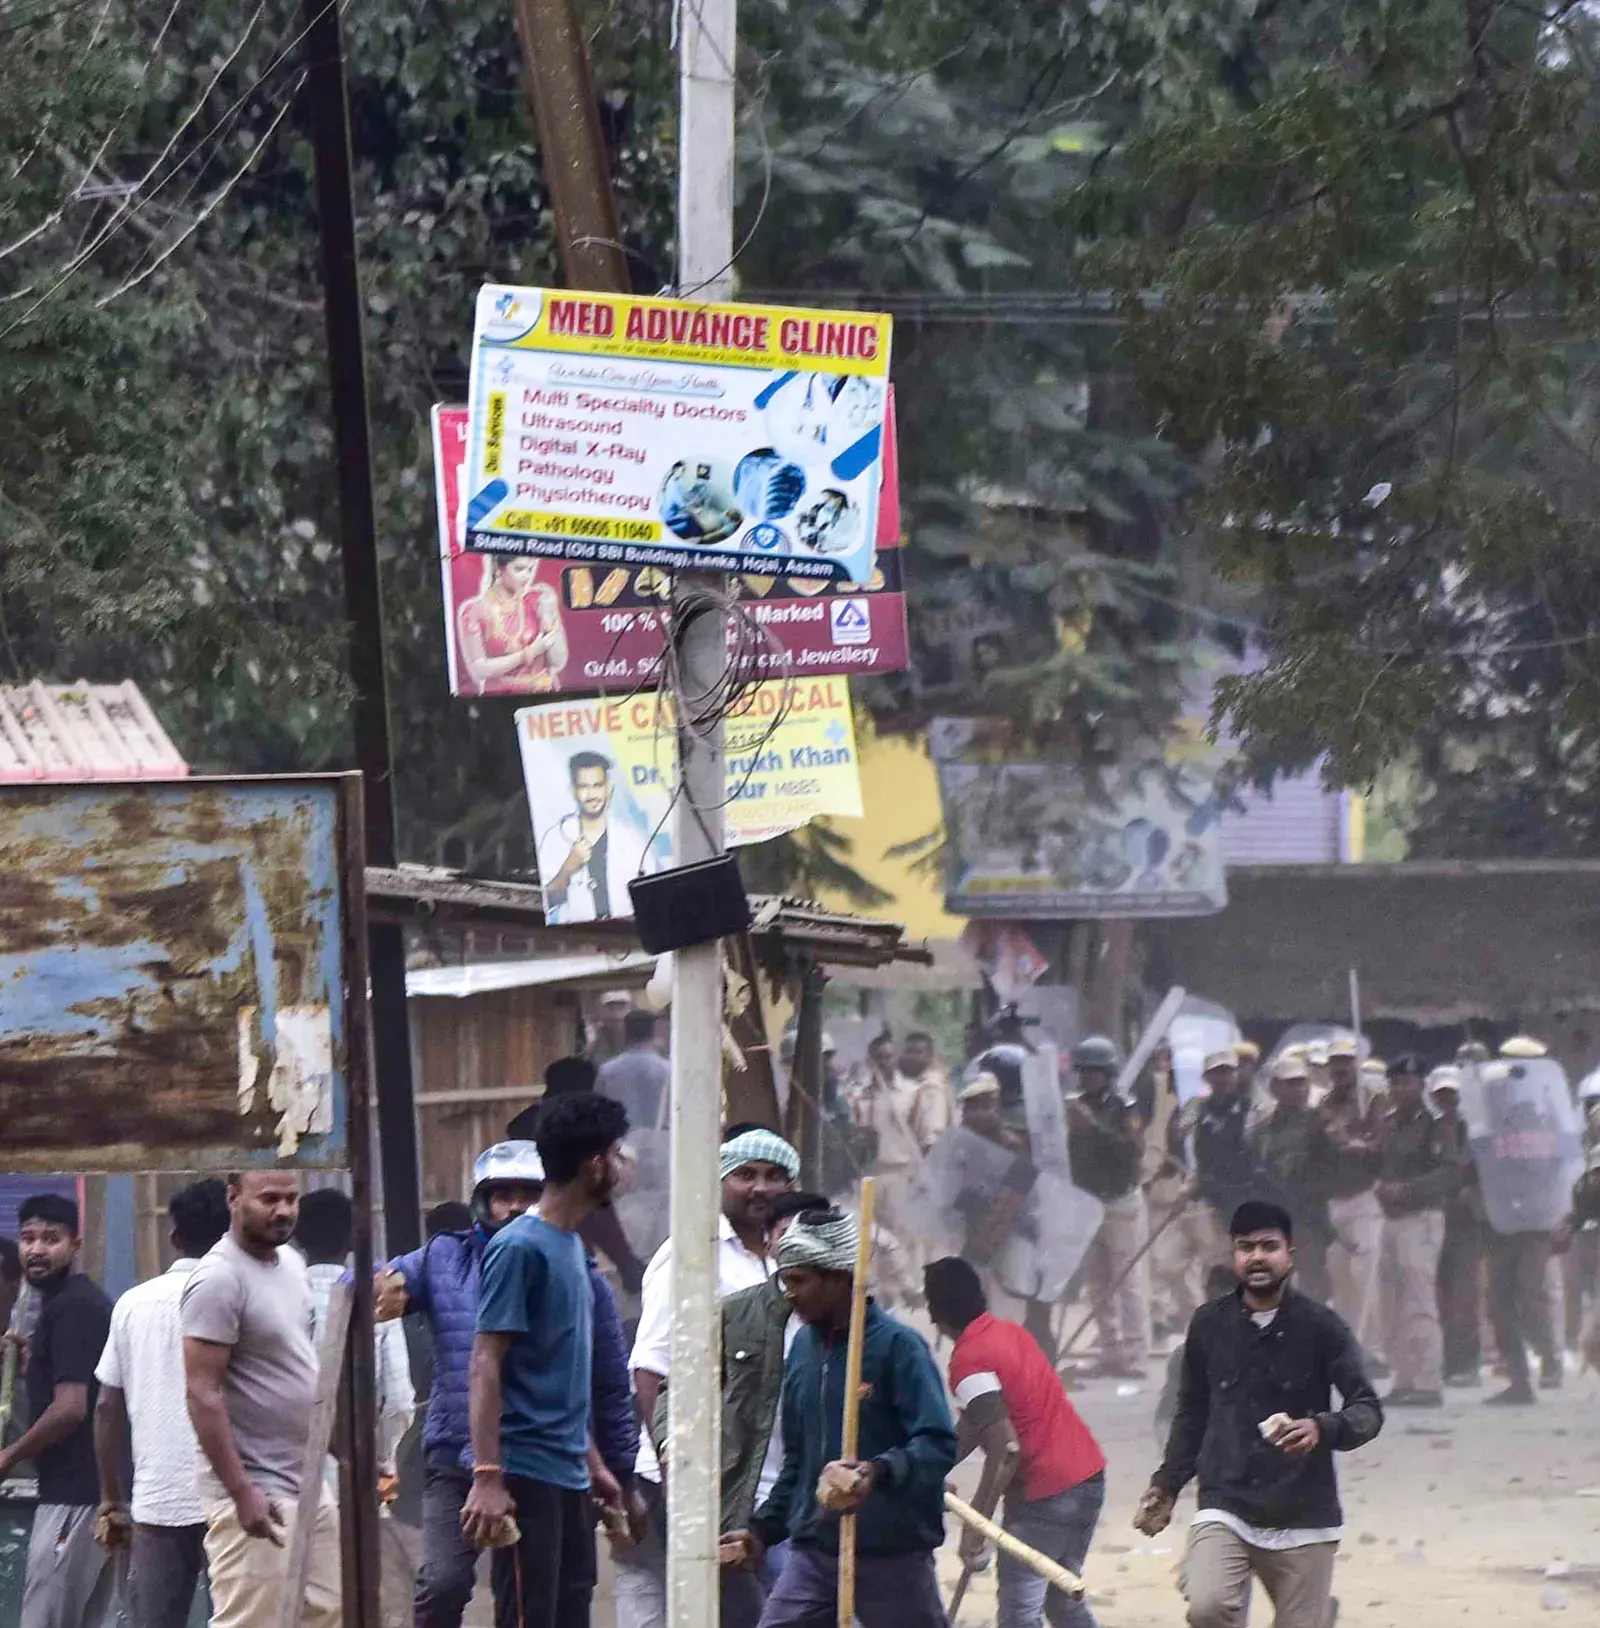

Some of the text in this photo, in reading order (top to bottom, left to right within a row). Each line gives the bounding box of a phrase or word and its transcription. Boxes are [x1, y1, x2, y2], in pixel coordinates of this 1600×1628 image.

[550, 300, 615, 338] MED
[625, 306, 770, 349] ADVANCE
[780, 318, 879, 361] CLINIC
[523, 389, 747, 423] Multi Speciality Doctors
[521, 412, 623, 435] Ultrasound
[519, 435, 647, 464] Digital X-Ray
[518, 459, 615, 484] Pathology
[474, 534, 525, 551] Station
[526, 539, 564, 556] Road
[565, 541, 596, 560] (Old
[785, 560, 834, 576] Assam
[600, 613, 636, 633] 100
[755, 602, 824, 623] Marked
[584, 658, 634, 677] Gold,
[796, 647, 880, 665] Jewellery
[526, 705, 623, 741] NERVE
[728, 683, 843, 717] EDICAL
[791, 746, 850, 768] Khan
